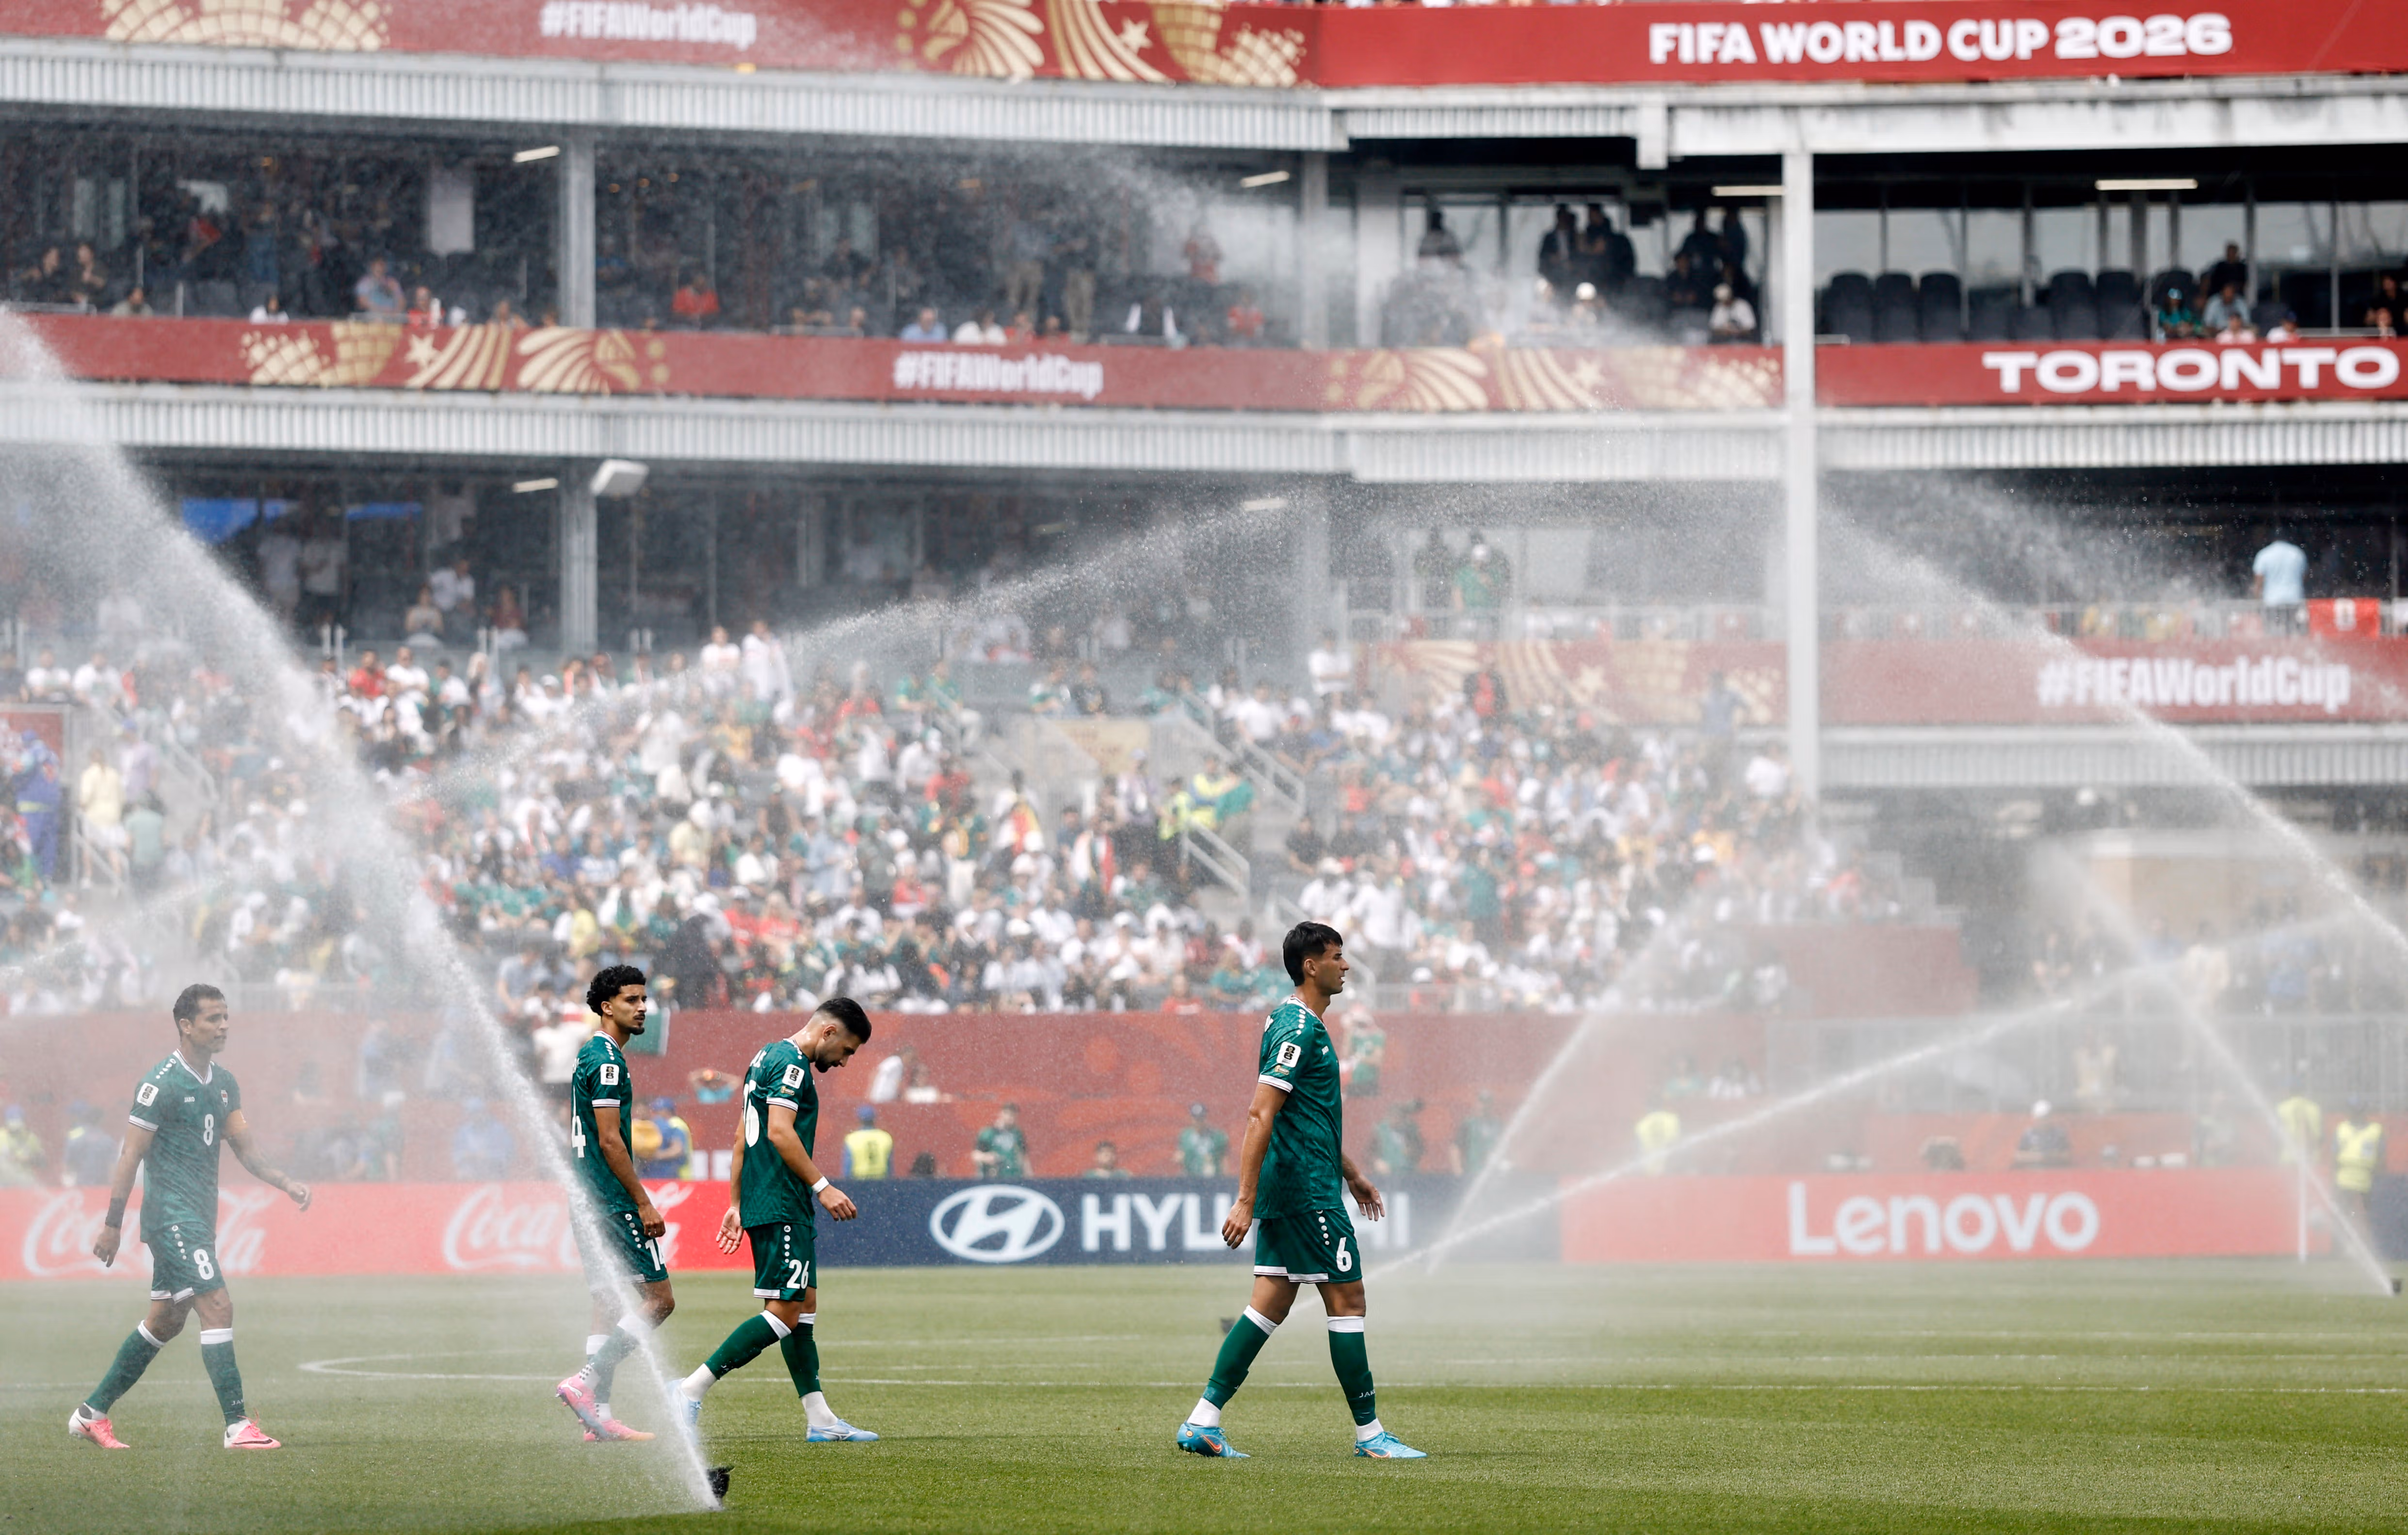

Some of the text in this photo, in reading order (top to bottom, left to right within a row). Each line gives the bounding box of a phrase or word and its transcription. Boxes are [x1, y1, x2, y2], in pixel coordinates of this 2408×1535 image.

[539, 1, 757, 51] #FIFAWorldCup
[1649, 13, 2232, 64] FIFA WORLD CUP 2026
[893, 351, 1103, 401] #FIFAWorldCup
[1982, 345, 2400, 394] TORONTO
[2037, 654, 2351, 714] #FIFAWorldCup
[203, 1113, 214, 1146] 8
[1788, 1181, 2100, 1256] Lenovo
[194, 1248, 214, 1280] 8
[786, 1259, 810, 1290] 26
[1336, 1237, 1353, 1273] 6
